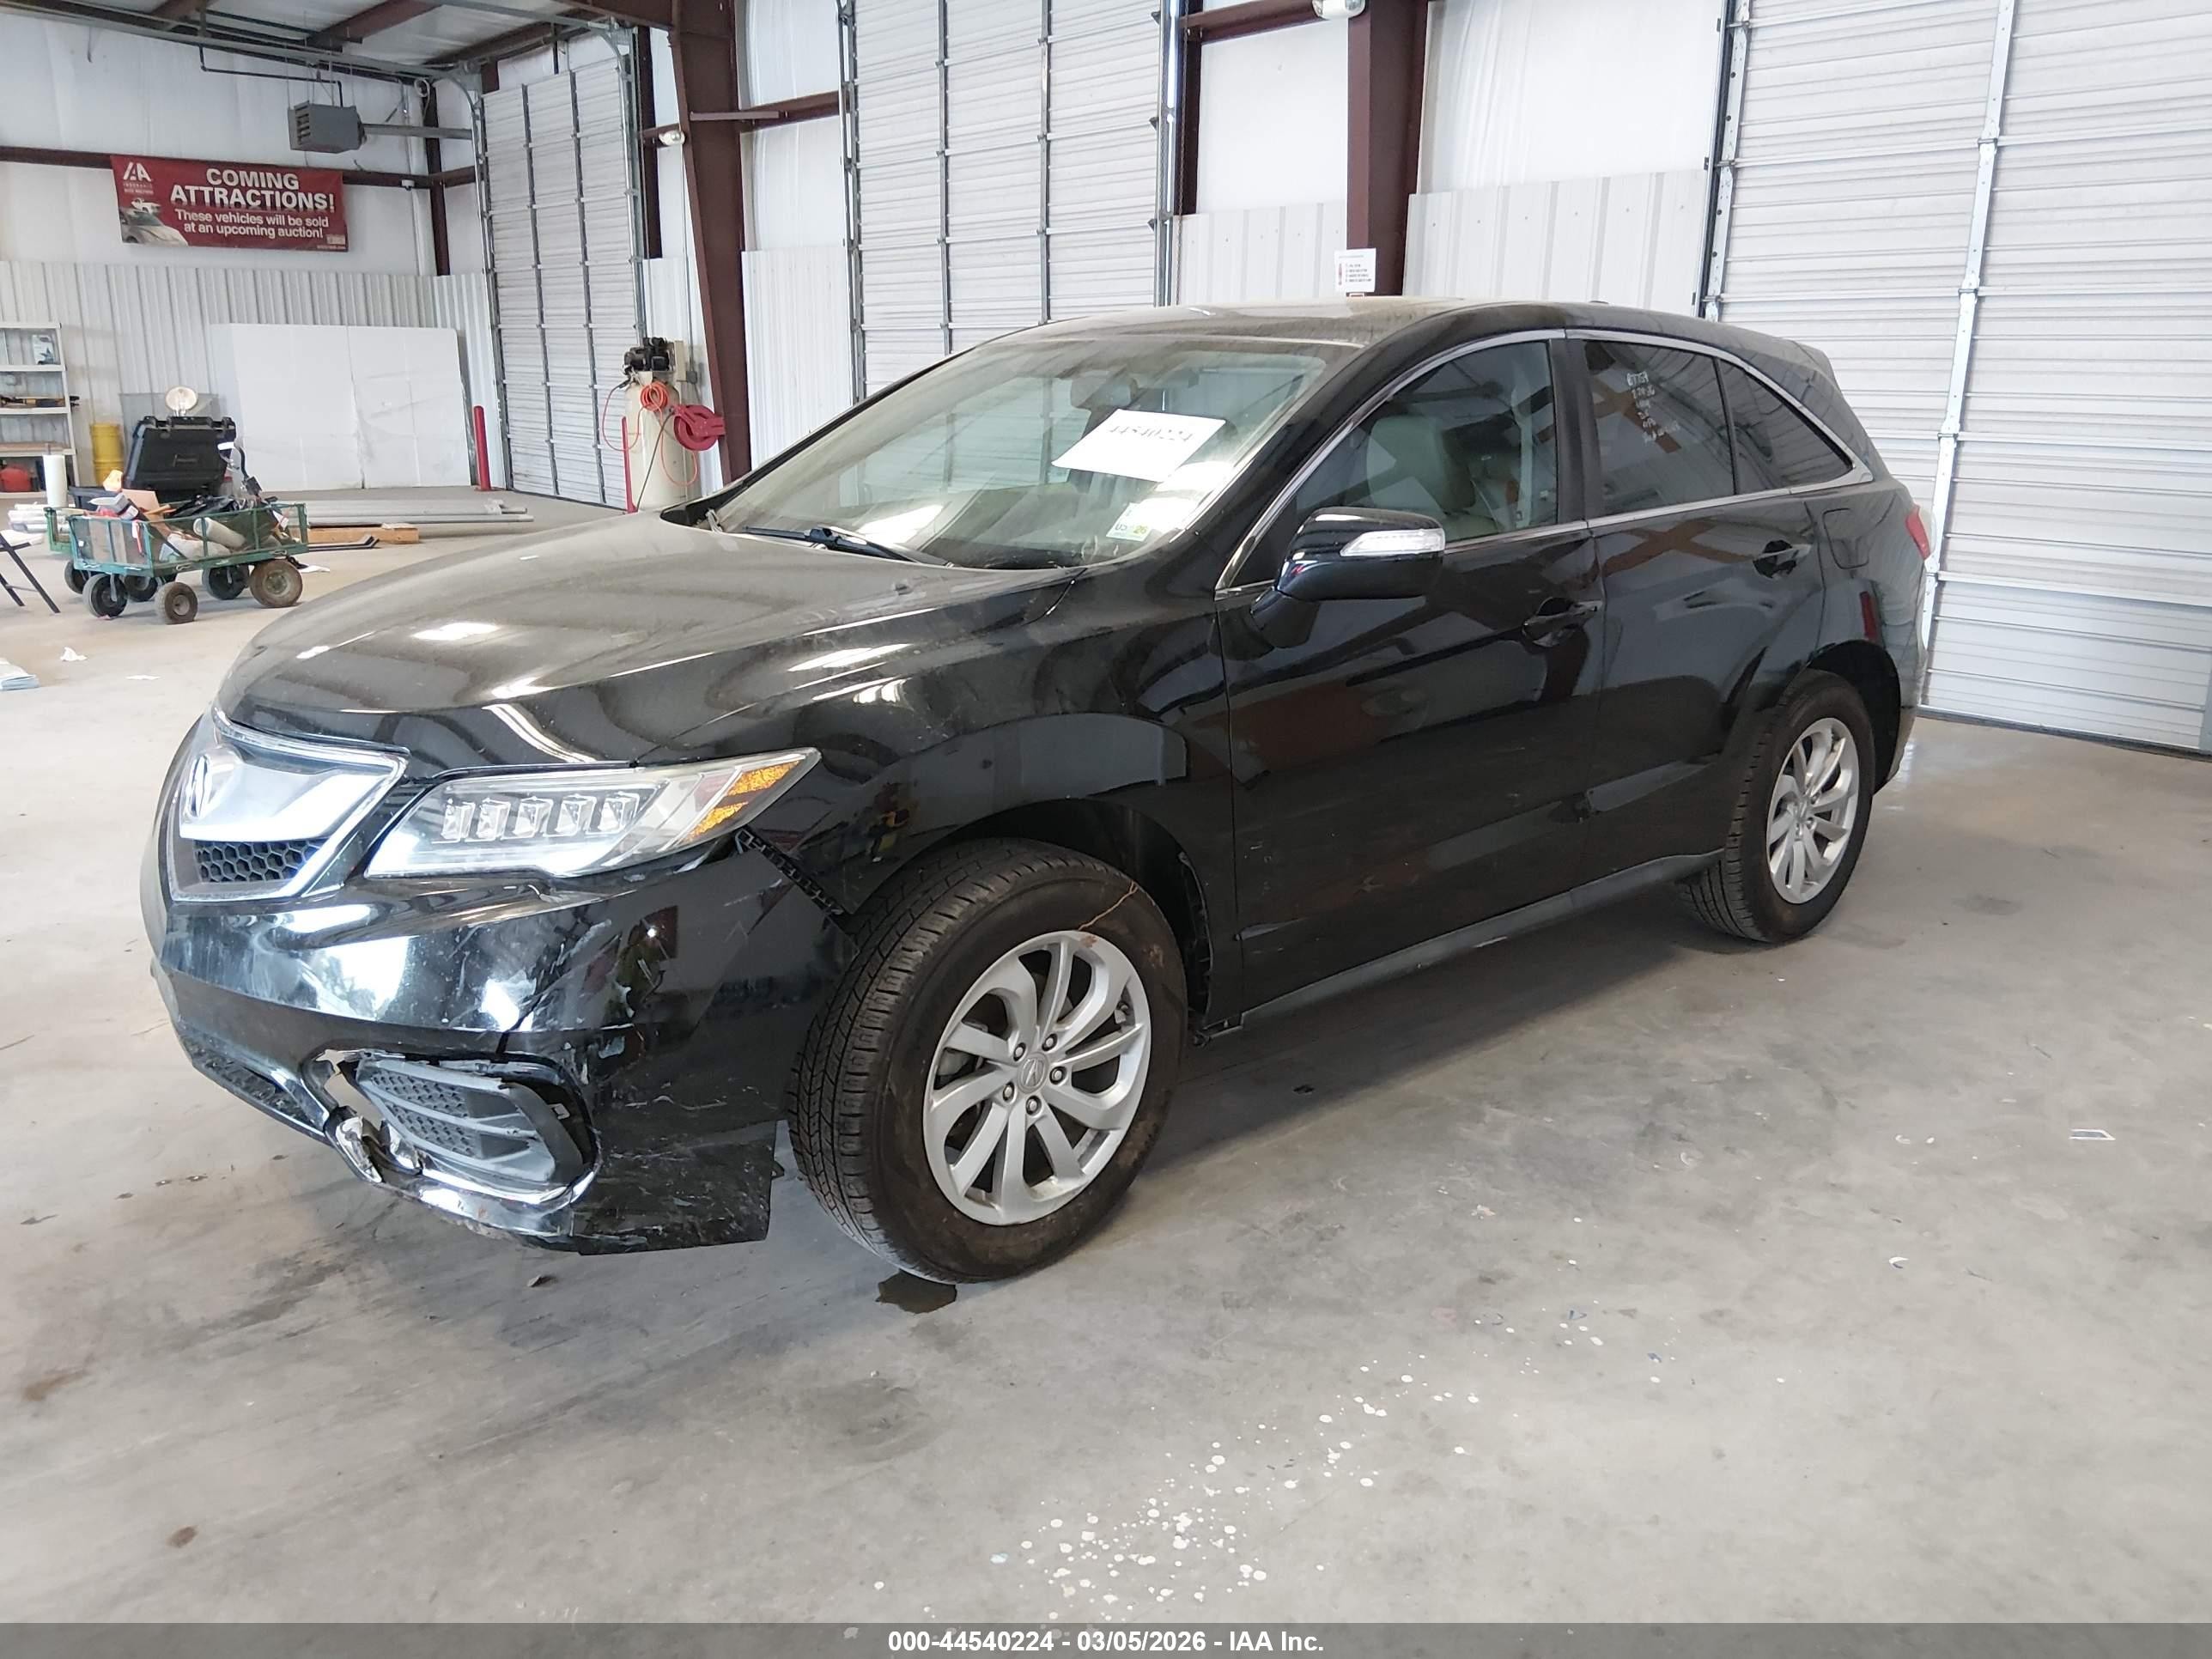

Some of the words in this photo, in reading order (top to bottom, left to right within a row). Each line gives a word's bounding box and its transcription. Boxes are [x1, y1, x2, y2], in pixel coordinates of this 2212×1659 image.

[206, 168, 299, 190] COMING
[170, 185, 334, 213] ATTRACTIONS!
[174, 209, 212, 222] These
[215, 212, 264, 224] vehicles
[266, 215, 285, 226] will
[287, 215, 302, 226] be
[305, 216, 329, 228] sold
[184, 222, 196, 233] at
[198, 224, 213, 234] an
[216, 225, 275, 240] upcoming
[277, 227, 323, 239] auction!
